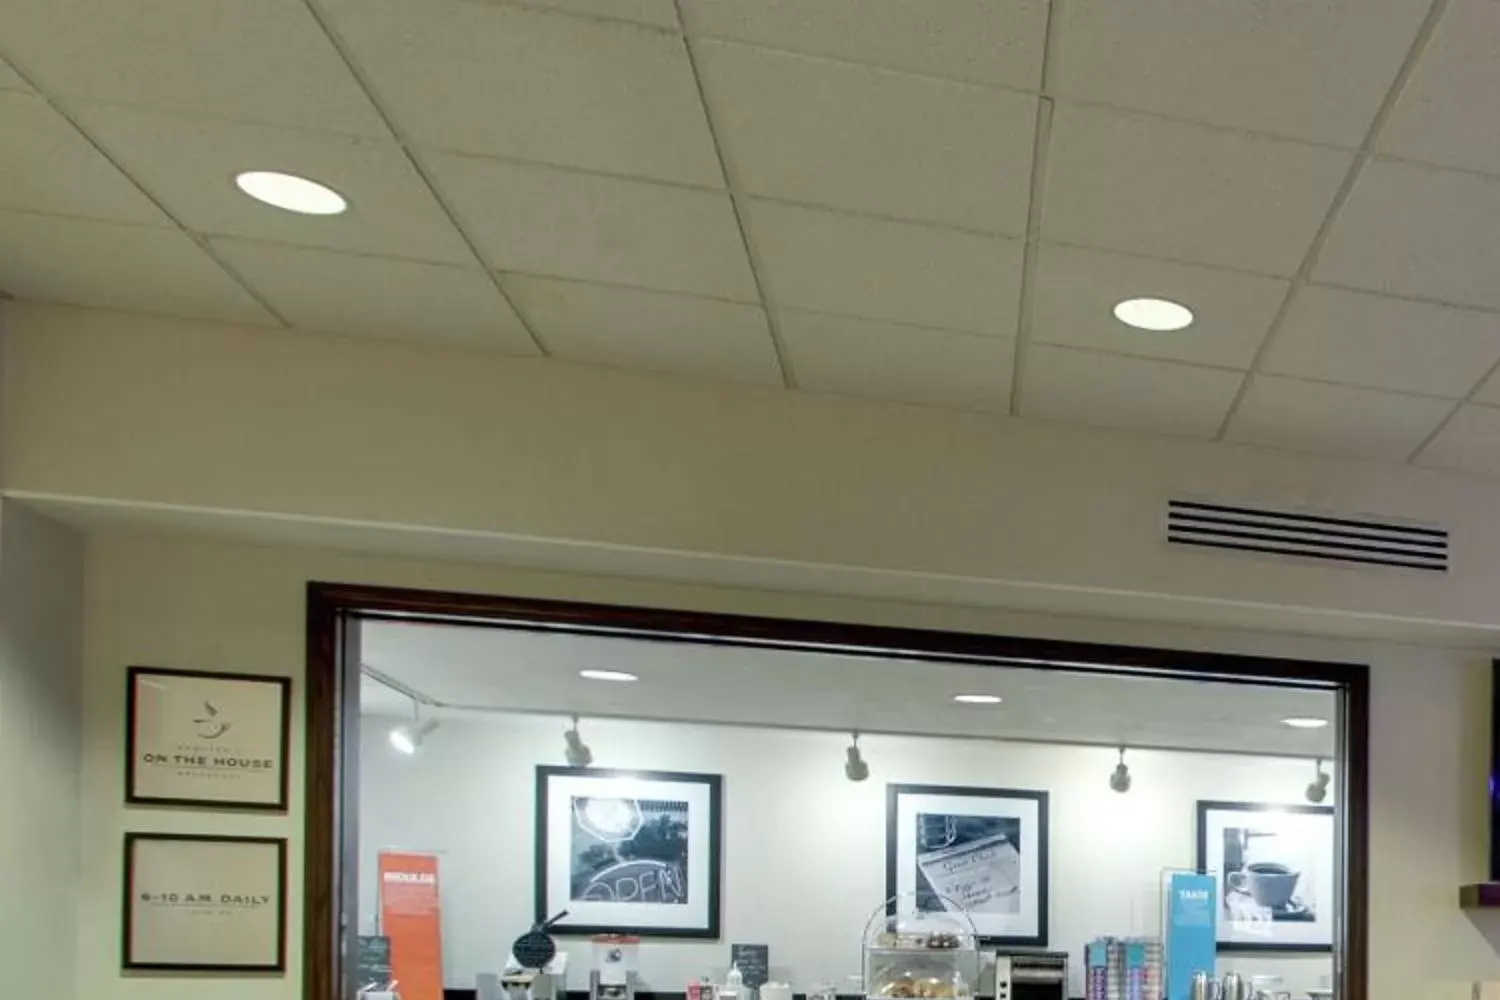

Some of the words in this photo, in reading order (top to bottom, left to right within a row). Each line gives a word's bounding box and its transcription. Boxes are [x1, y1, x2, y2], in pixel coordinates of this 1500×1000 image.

[143, 752, 168, 763] ON
[174, 754, 207, 765] THE
[213, 757, 273, 769] HOUSE
[220, 894, 270, 905] DAILY
